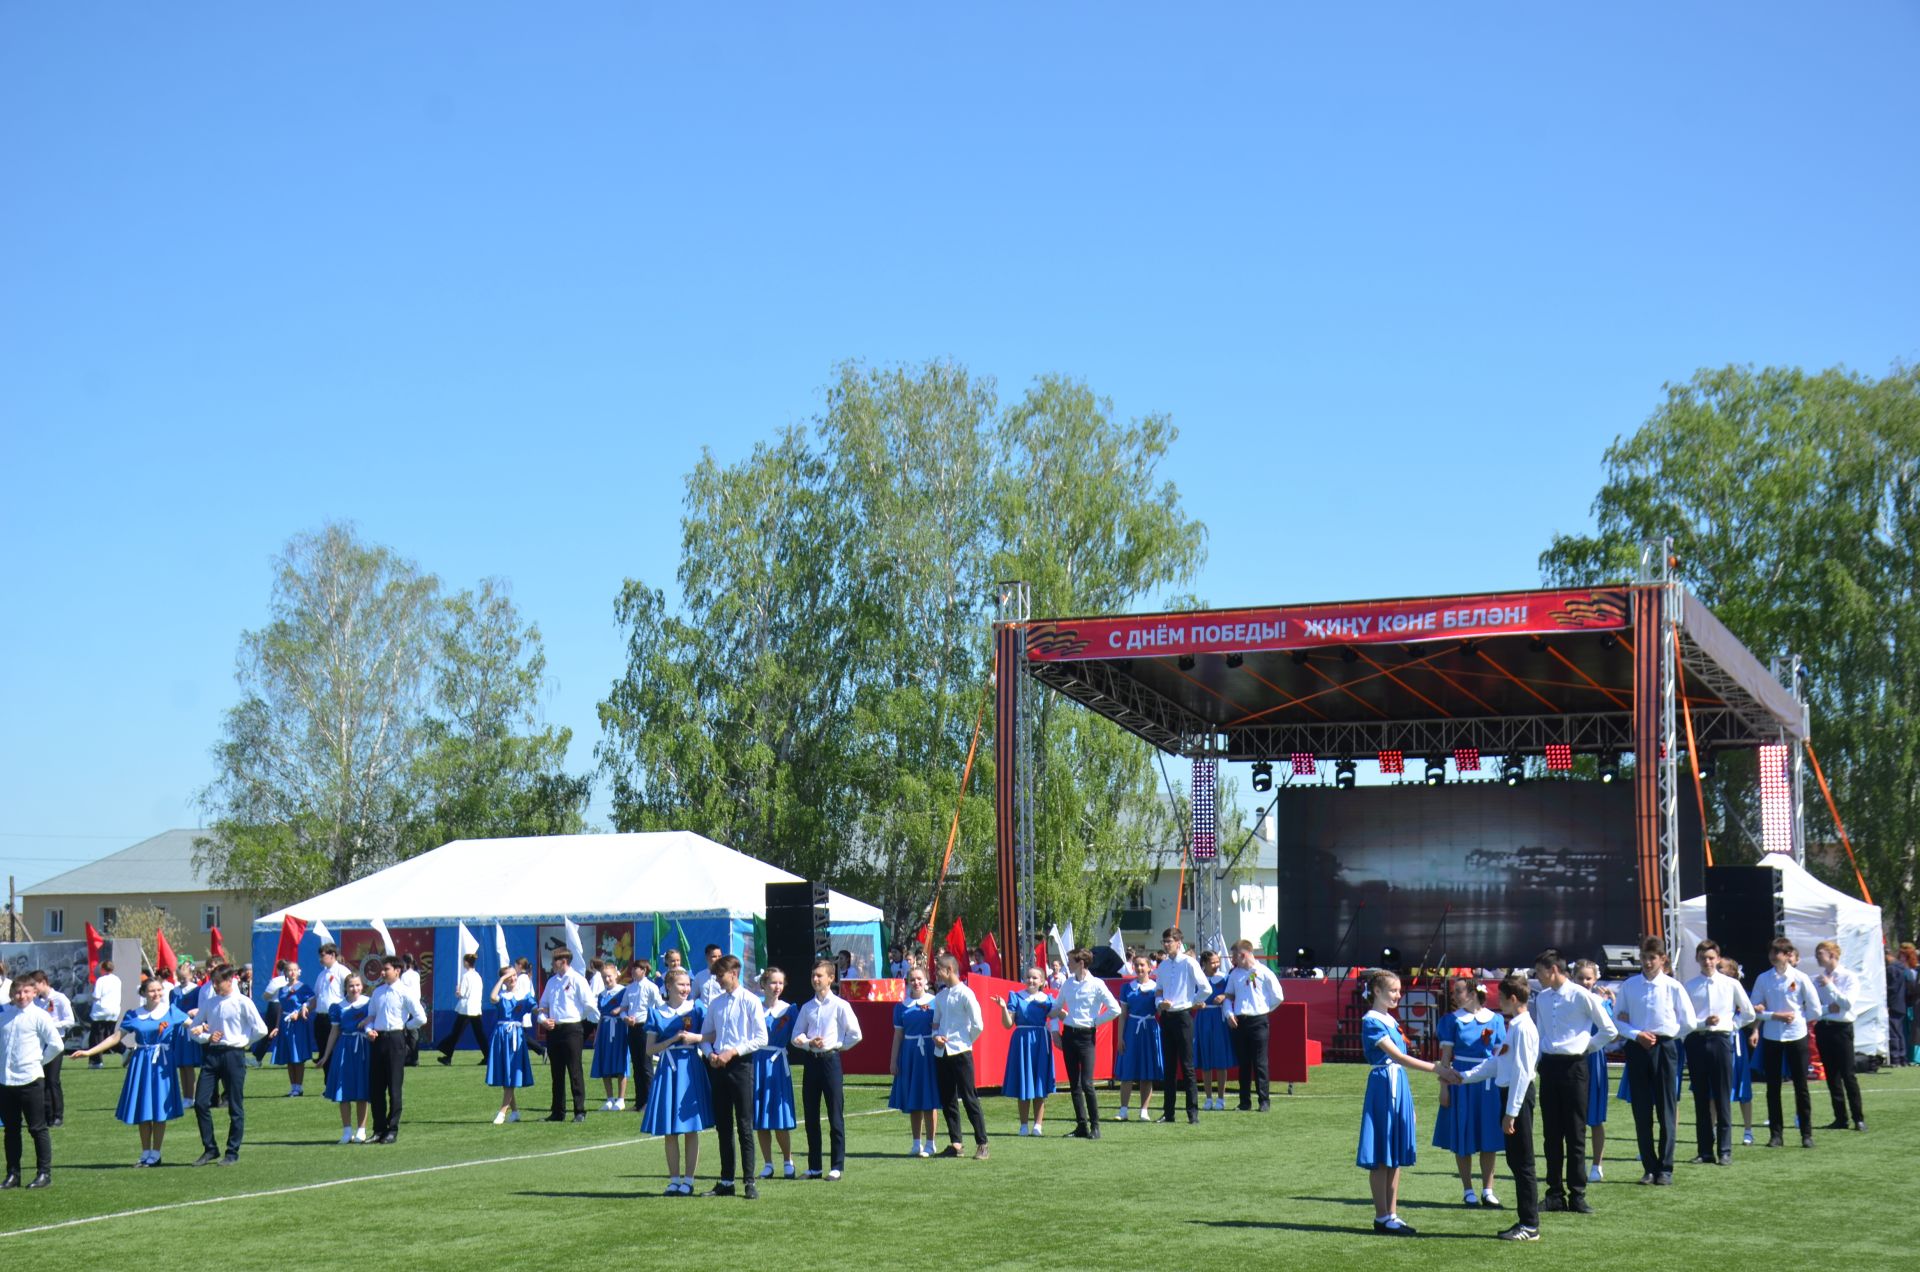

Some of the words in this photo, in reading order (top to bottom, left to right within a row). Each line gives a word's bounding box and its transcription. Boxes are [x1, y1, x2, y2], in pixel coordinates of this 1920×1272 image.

[1108, 630, 1122, 648] С
[1126, 624, 1185, 650] ДНЁМ
[1191, 621, 1287, 645] ПОБЕДЫ!
[1378, 612, 1437, 633] КӨНЕ
[1443, 606, 1528, 629] БЕЛӘН!
